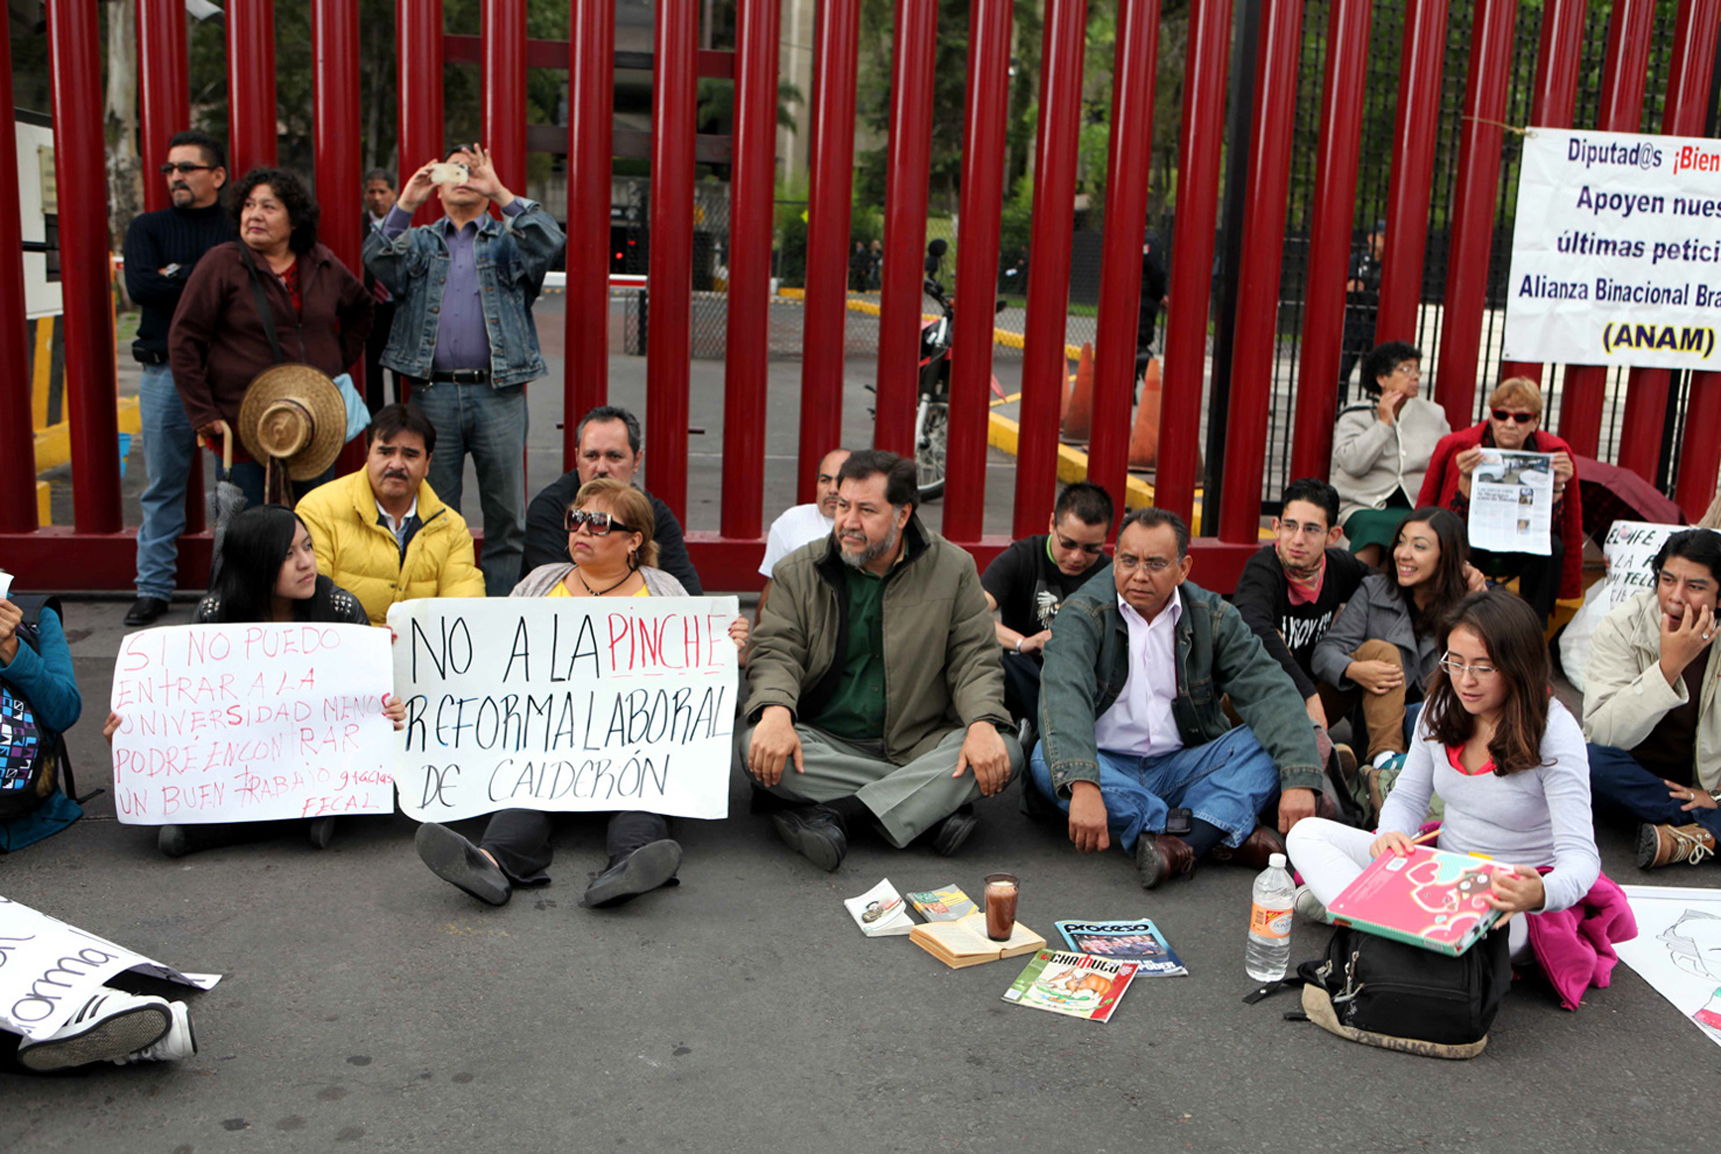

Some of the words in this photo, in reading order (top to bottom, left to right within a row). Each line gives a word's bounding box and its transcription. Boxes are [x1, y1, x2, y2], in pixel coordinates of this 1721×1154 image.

[1568, 138, 1662, 170] Diputad@s
[1577, 186, 1664, 218] Apoyen
[1557, 230, 1645, 258] últimas
[1519, 275, 1588, 300] Alianza
[1595, 278, 1689, 305] Binacional
[1603, 322, 1715, 360] (ANAM)
[123, 632, 166, 672] SI
[187, 630, 230, 667] NO
[244, 626, 341, 660] PUEDO
[411, 615, 473, 684] NO
[503, 616, 530, 683] A
[550, 613, 600, 683] LA
[607, 606, 727, 672] PINCHE
[116, 668, 239, 709] ENTRAR
[276, 667, 315, 695] LA
[119, 701, 312, 736] UNIVERSIDAD
[404, 691, 575, 753] REFORMA
[583, 685, 733, 751] LABORAL
[416, 764, 461, 809] DE
[488, 750, 670, 803] CALDERÓN
[119, 791, 147, 816] UN
[162, 782, 225, 815] BUEN
[300, 793, 379, 818] FECAL
[1063, 923, 1149, 934] proceso
